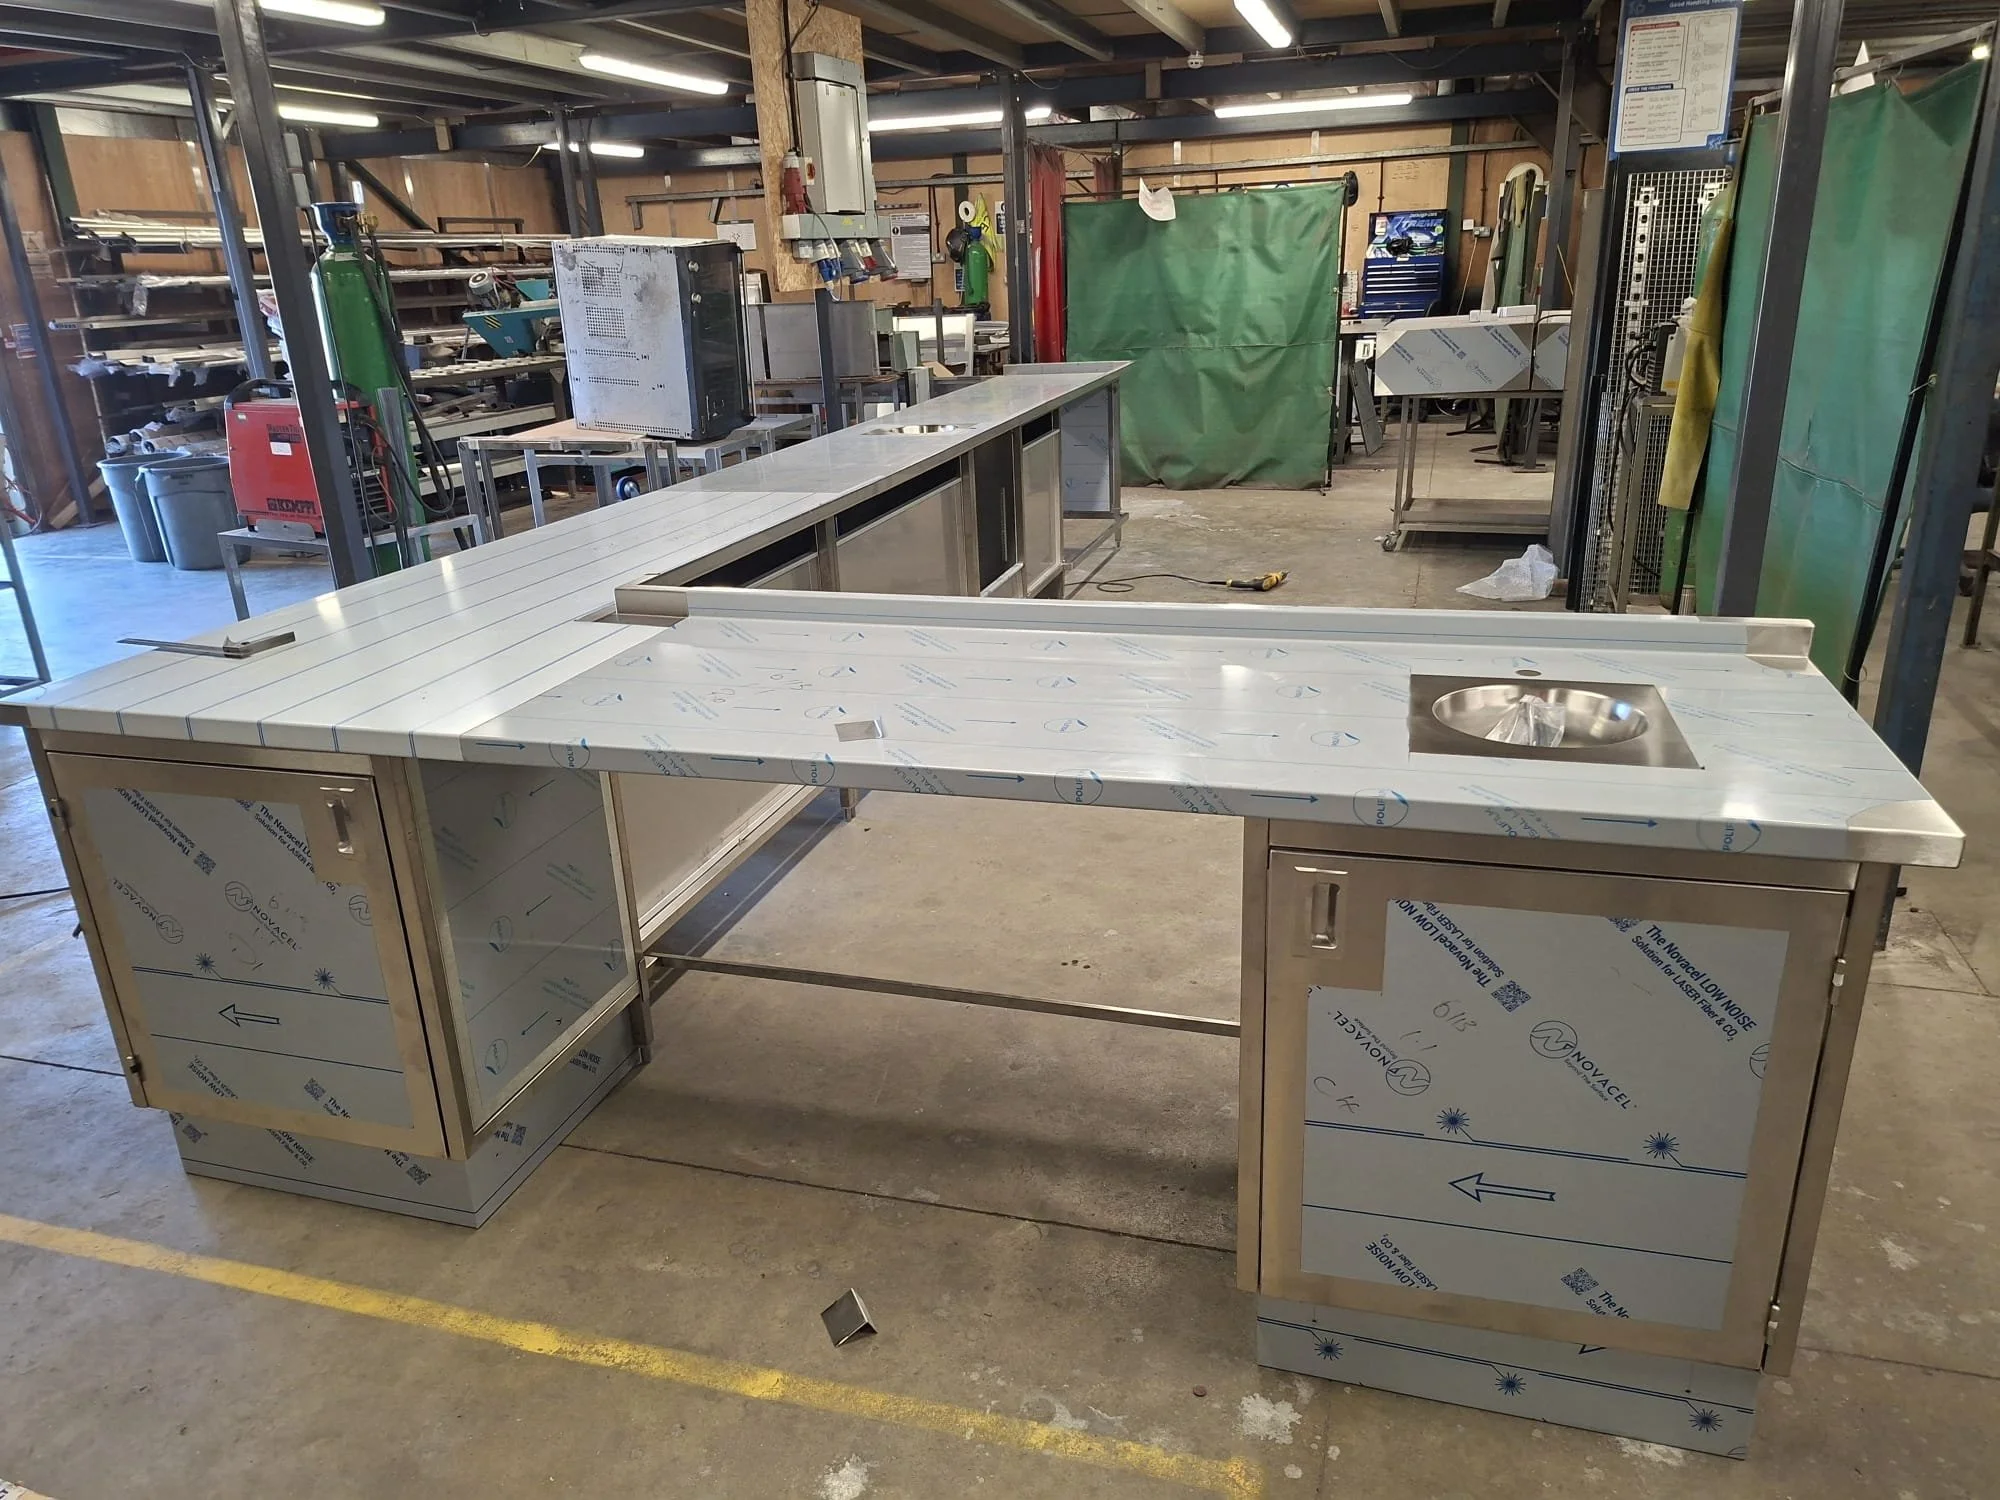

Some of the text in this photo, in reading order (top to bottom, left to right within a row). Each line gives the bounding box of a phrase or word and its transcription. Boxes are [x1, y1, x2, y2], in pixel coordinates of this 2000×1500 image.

[1168, 785, 1199, 813] OLIFILM
[254, 813, 278, 838] Solution
[278, 834, 288, 846] for
[286, 844, 308, 865] LASER
[260, 804, 274, 821] The
[273, 818, 304, 849] Novacel
[113, 878, 157, 921] NOVACEL
[252, 904, 297, 951] NOVACEL
[1412, 913, 1440, 938] LOW
[1436, 911, 1466, 940] LASER
[1462, 936, 1476, 951] for
[1433, 932, 1476, 972] Novacel
[1472, 946, 1505, 979] Solution
[1471, 966, 1492, 988] The
[1631, 934, 1664, 969] Solution
[1661, 963, 1676, 978] for
[1672, 974, 1701, 1003] LASER
[1696, 997, 1719, 1021] Fiber
[1715, 1016, 1727, 1027] &
[1646, 924, 1757, 1033] The Novacel LOW NOISE
[1333, 1010, 1391, 1068] NOVACEL
[1571, 1051, 1631, 1109] NOVACEL
[328, 1096, 341, 1111] The
[1365, 1241, 1416, 1288] LOW NOISE
[1398, 1253, 1416, 1271] Fiber
[1413, 1268, 1439, 1291] LASER
[1598, 1289, 1617, 1309] The
